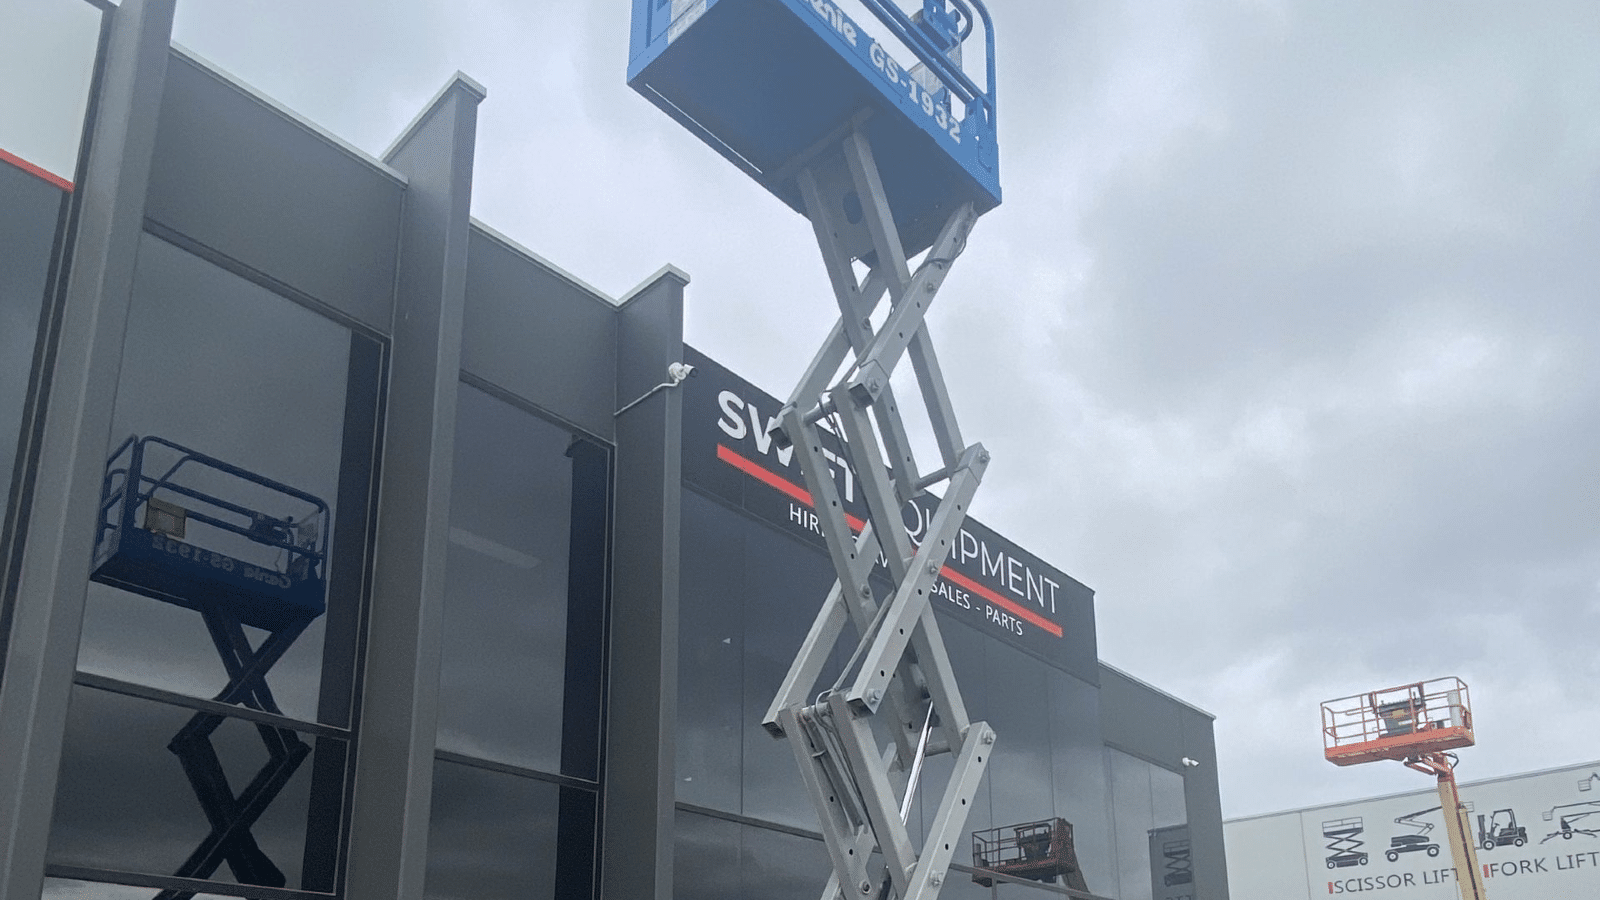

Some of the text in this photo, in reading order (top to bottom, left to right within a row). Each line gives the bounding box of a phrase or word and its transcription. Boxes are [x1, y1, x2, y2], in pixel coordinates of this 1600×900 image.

[806, 0, 960, 144] enie GS-1932
[789, 503, 826, 537] HIR
[985, 604, 1023, 636] PARTS
[1334, 872, 1417, 894] SCISSOR
[1489, 851, 1600, 878] FORK LIFT
